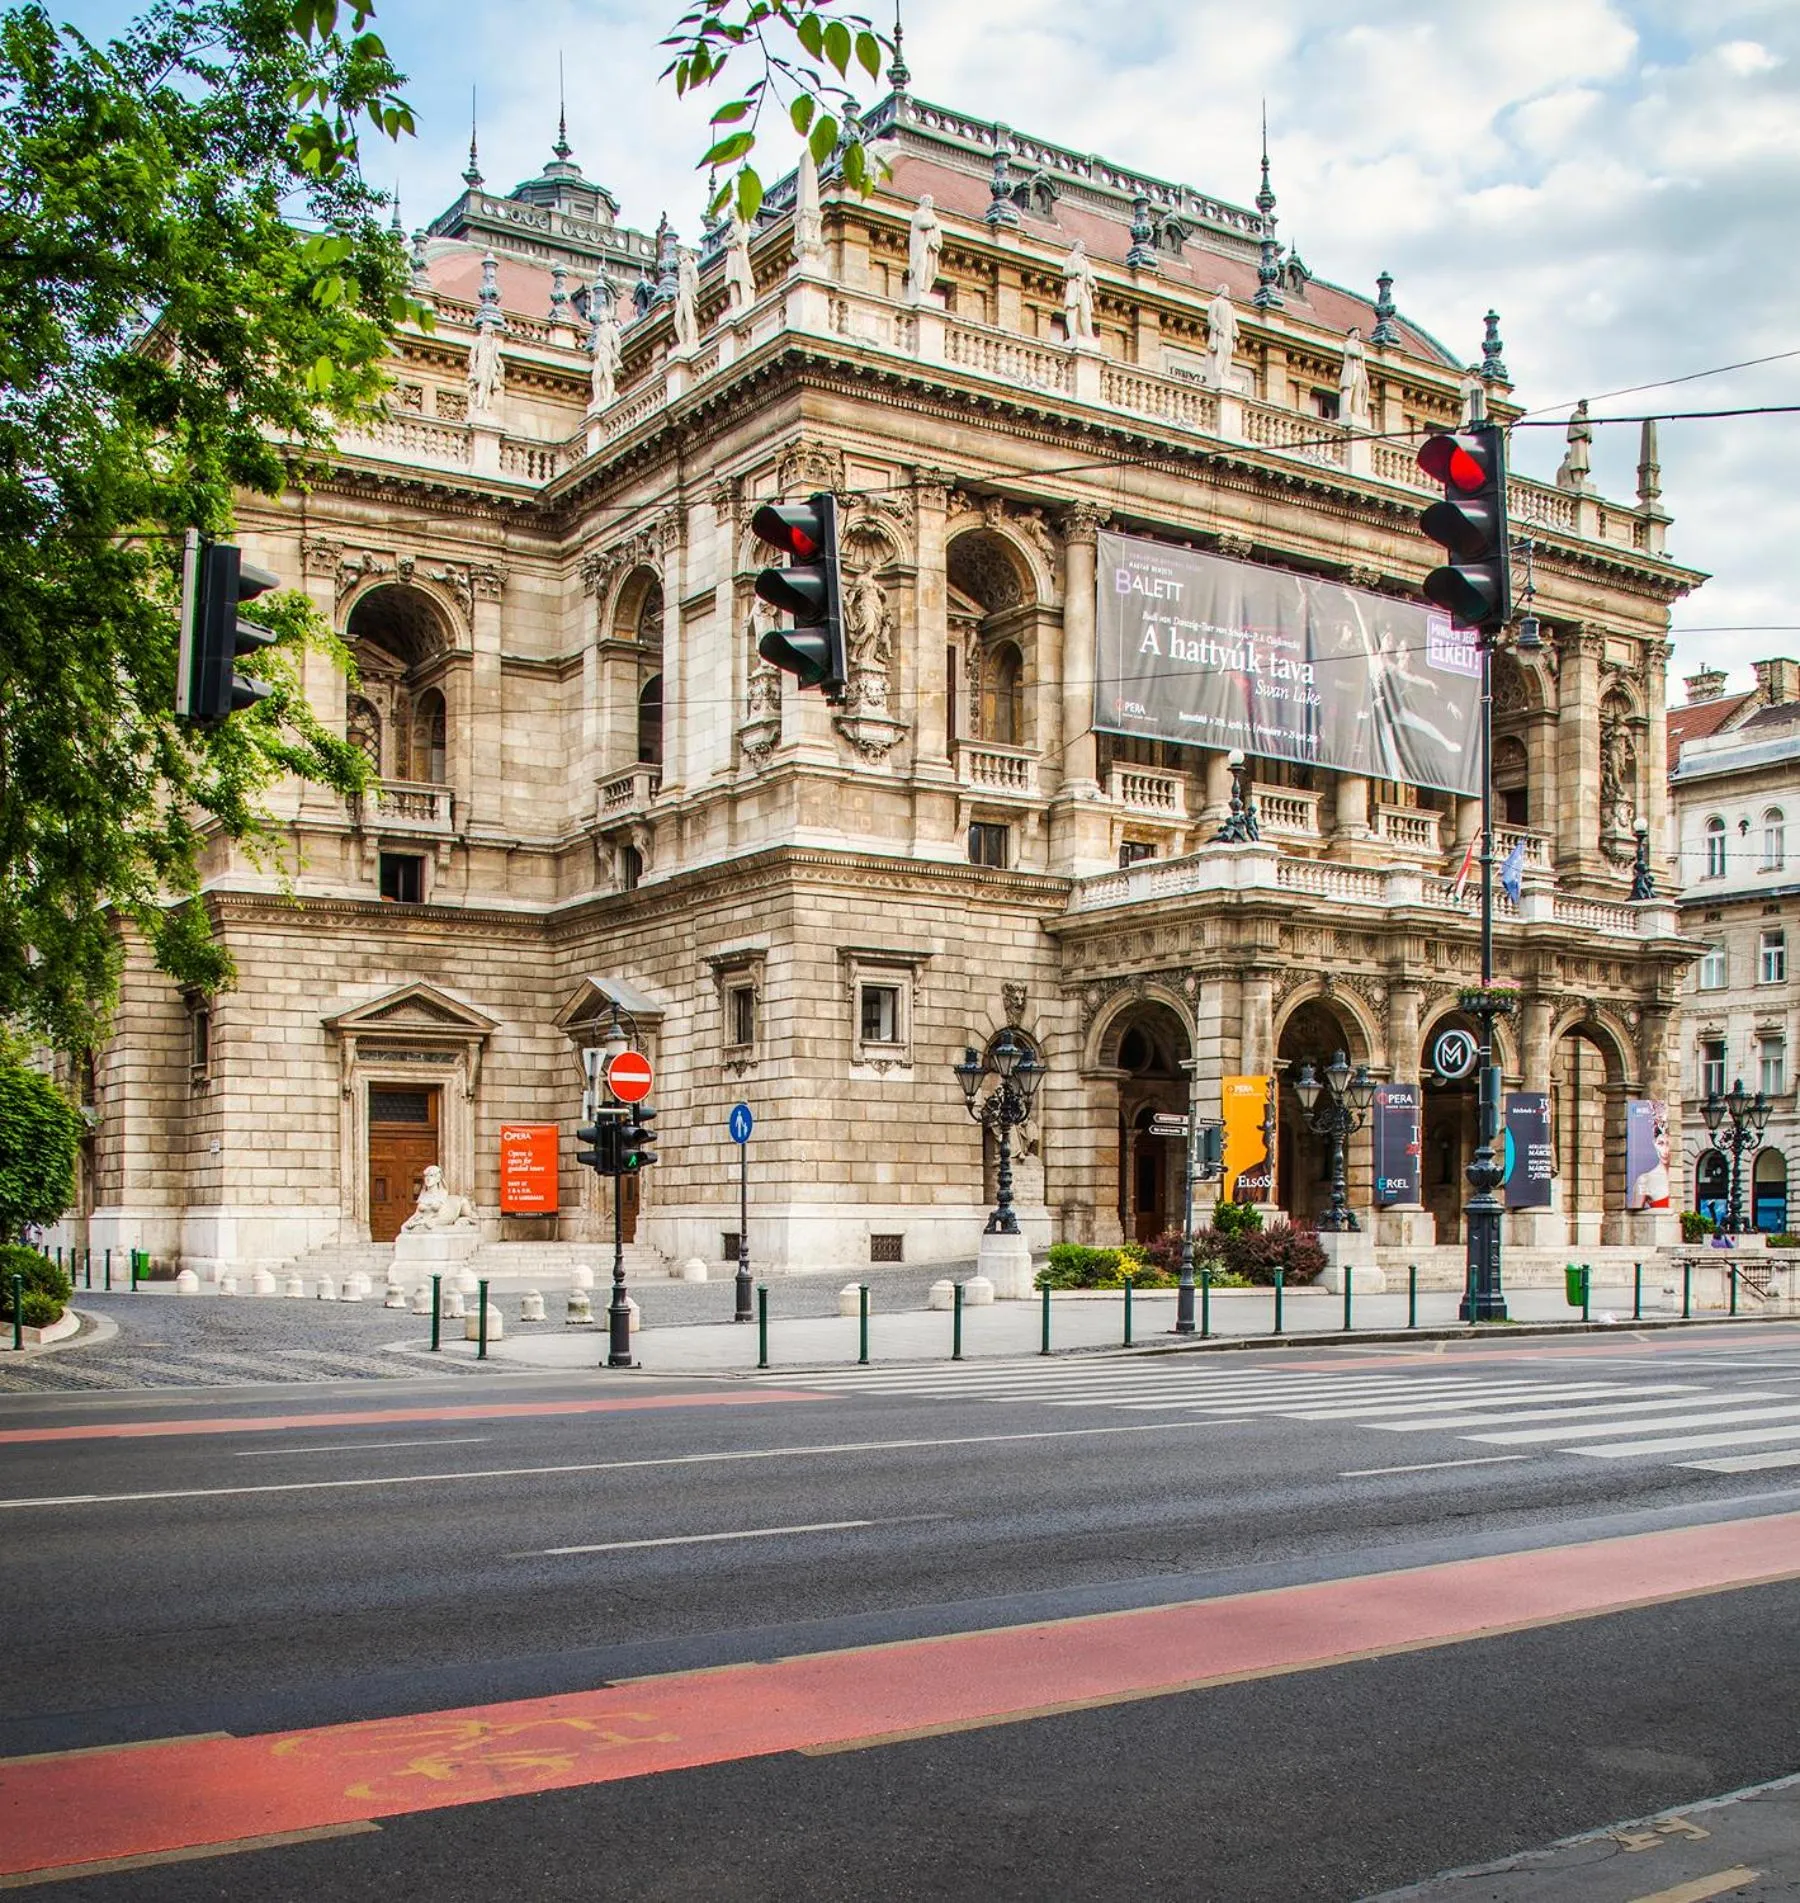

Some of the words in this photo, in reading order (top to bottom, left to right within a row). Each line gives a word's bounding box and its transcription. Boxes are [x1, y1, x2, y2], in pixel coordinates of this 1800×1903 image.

[1115, 568, 1184, 602] BALETT
[1139, 624, 1162, 656] A
[1169, 626, 1262, 676] hattyúk
[1269, 651, 1317, 685] tava
[1255, 679, 1290, 702] Swan
[1292, 686, 1322, 707] Lake
[1376, 1091, 1413, 1105] OPERA
[504, 1131, 532, 1141] OPERA
[1378, 1177, 1409, 1191] ERKEL
